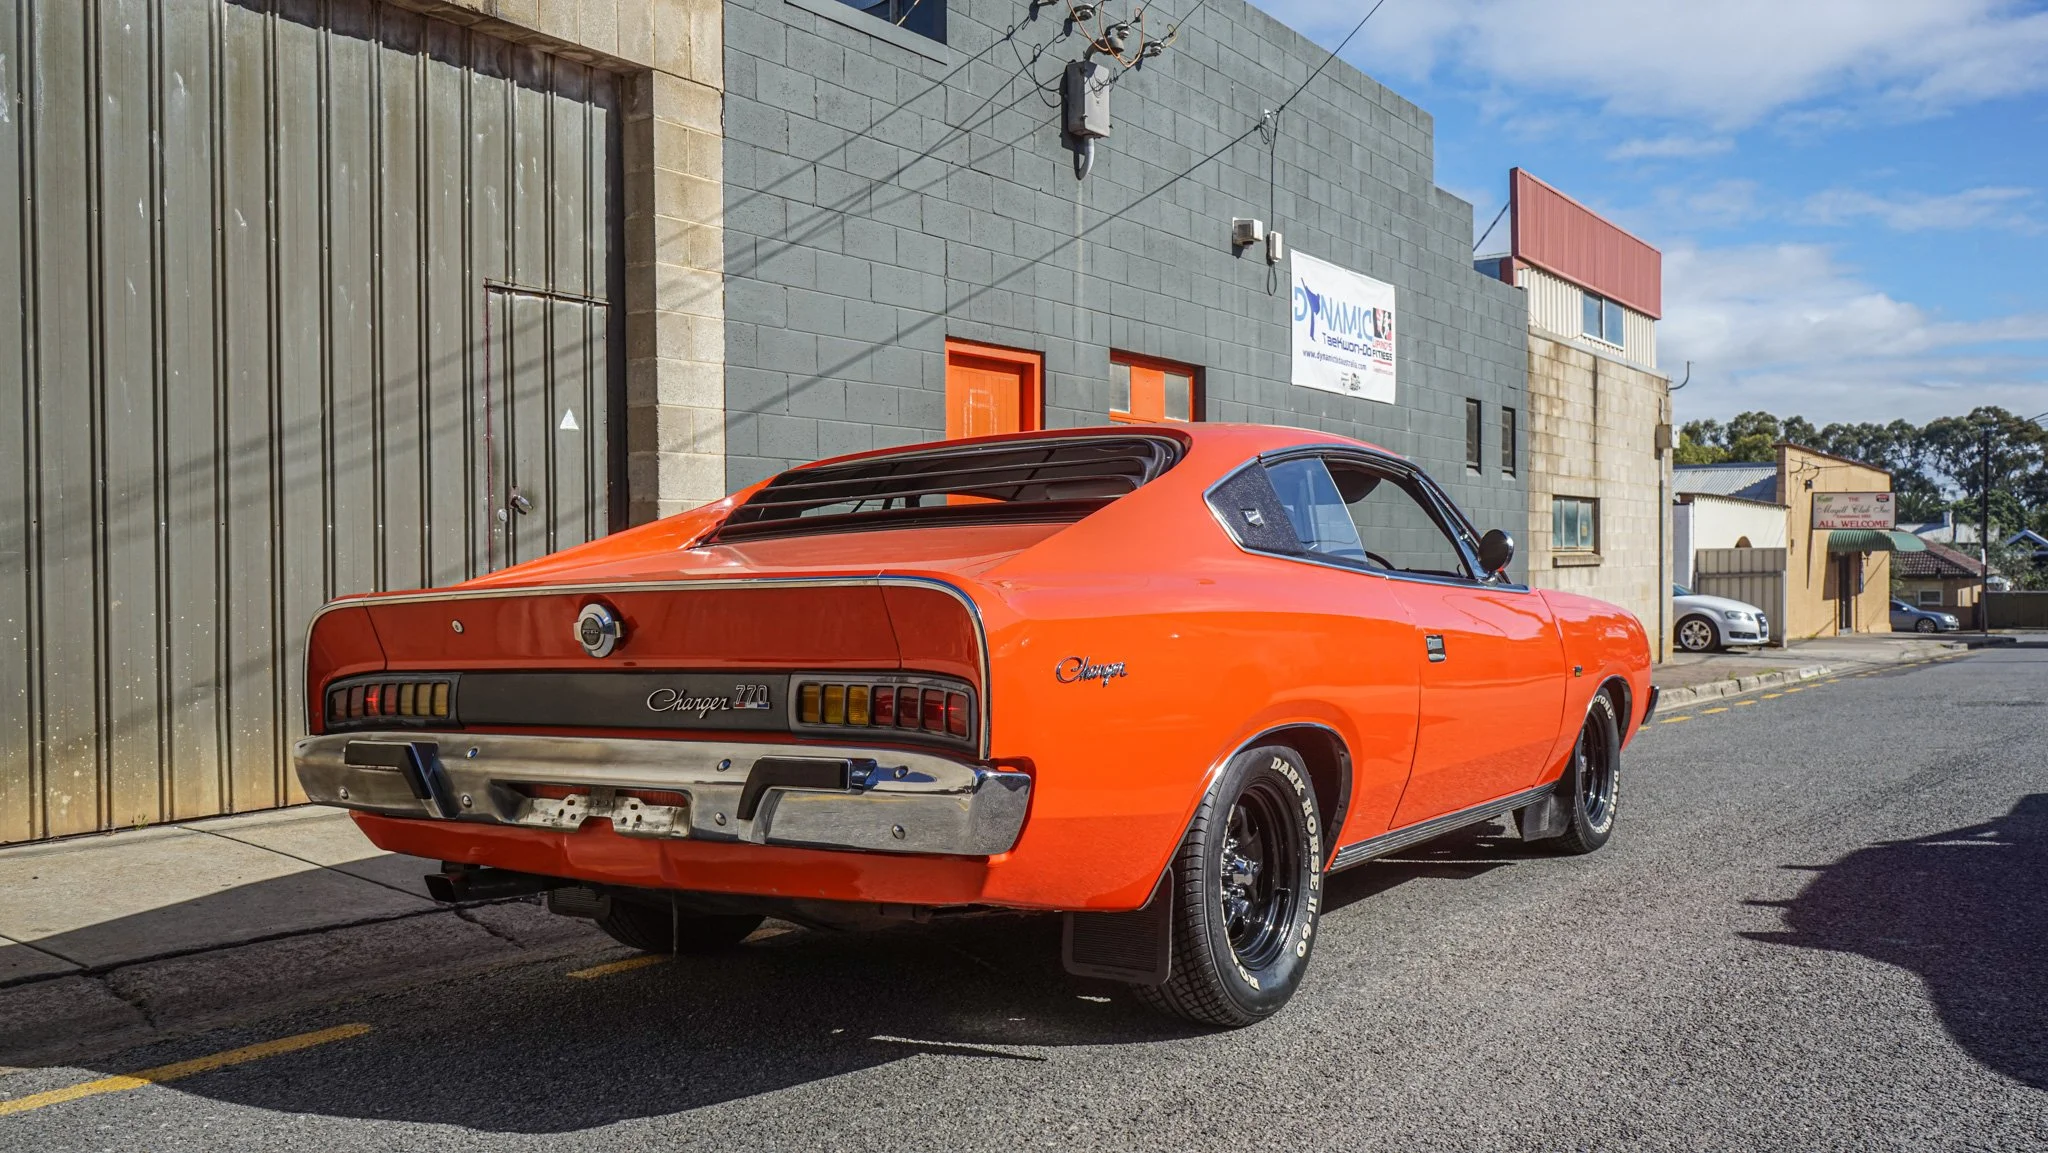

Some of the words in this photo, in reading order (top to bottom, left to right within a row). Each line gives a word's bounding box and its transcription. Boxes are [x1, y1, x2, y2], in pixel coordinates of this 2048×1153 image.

[1294, 277, 1373, 342] DYNAMIC
[1818, 520, 1837, 528] ALL
[1841, 520, 1888, 528] WELCOME
[1055, 656, 1128, 688] Charger
[646, 688, 730, 719] Charger
[735, 684, 769, 706] 770
[1610, 769, 1620, 815] DARK
[1270, 756, 1306, 797] DARK
[1301, 797, 1320, 891] HORSE
